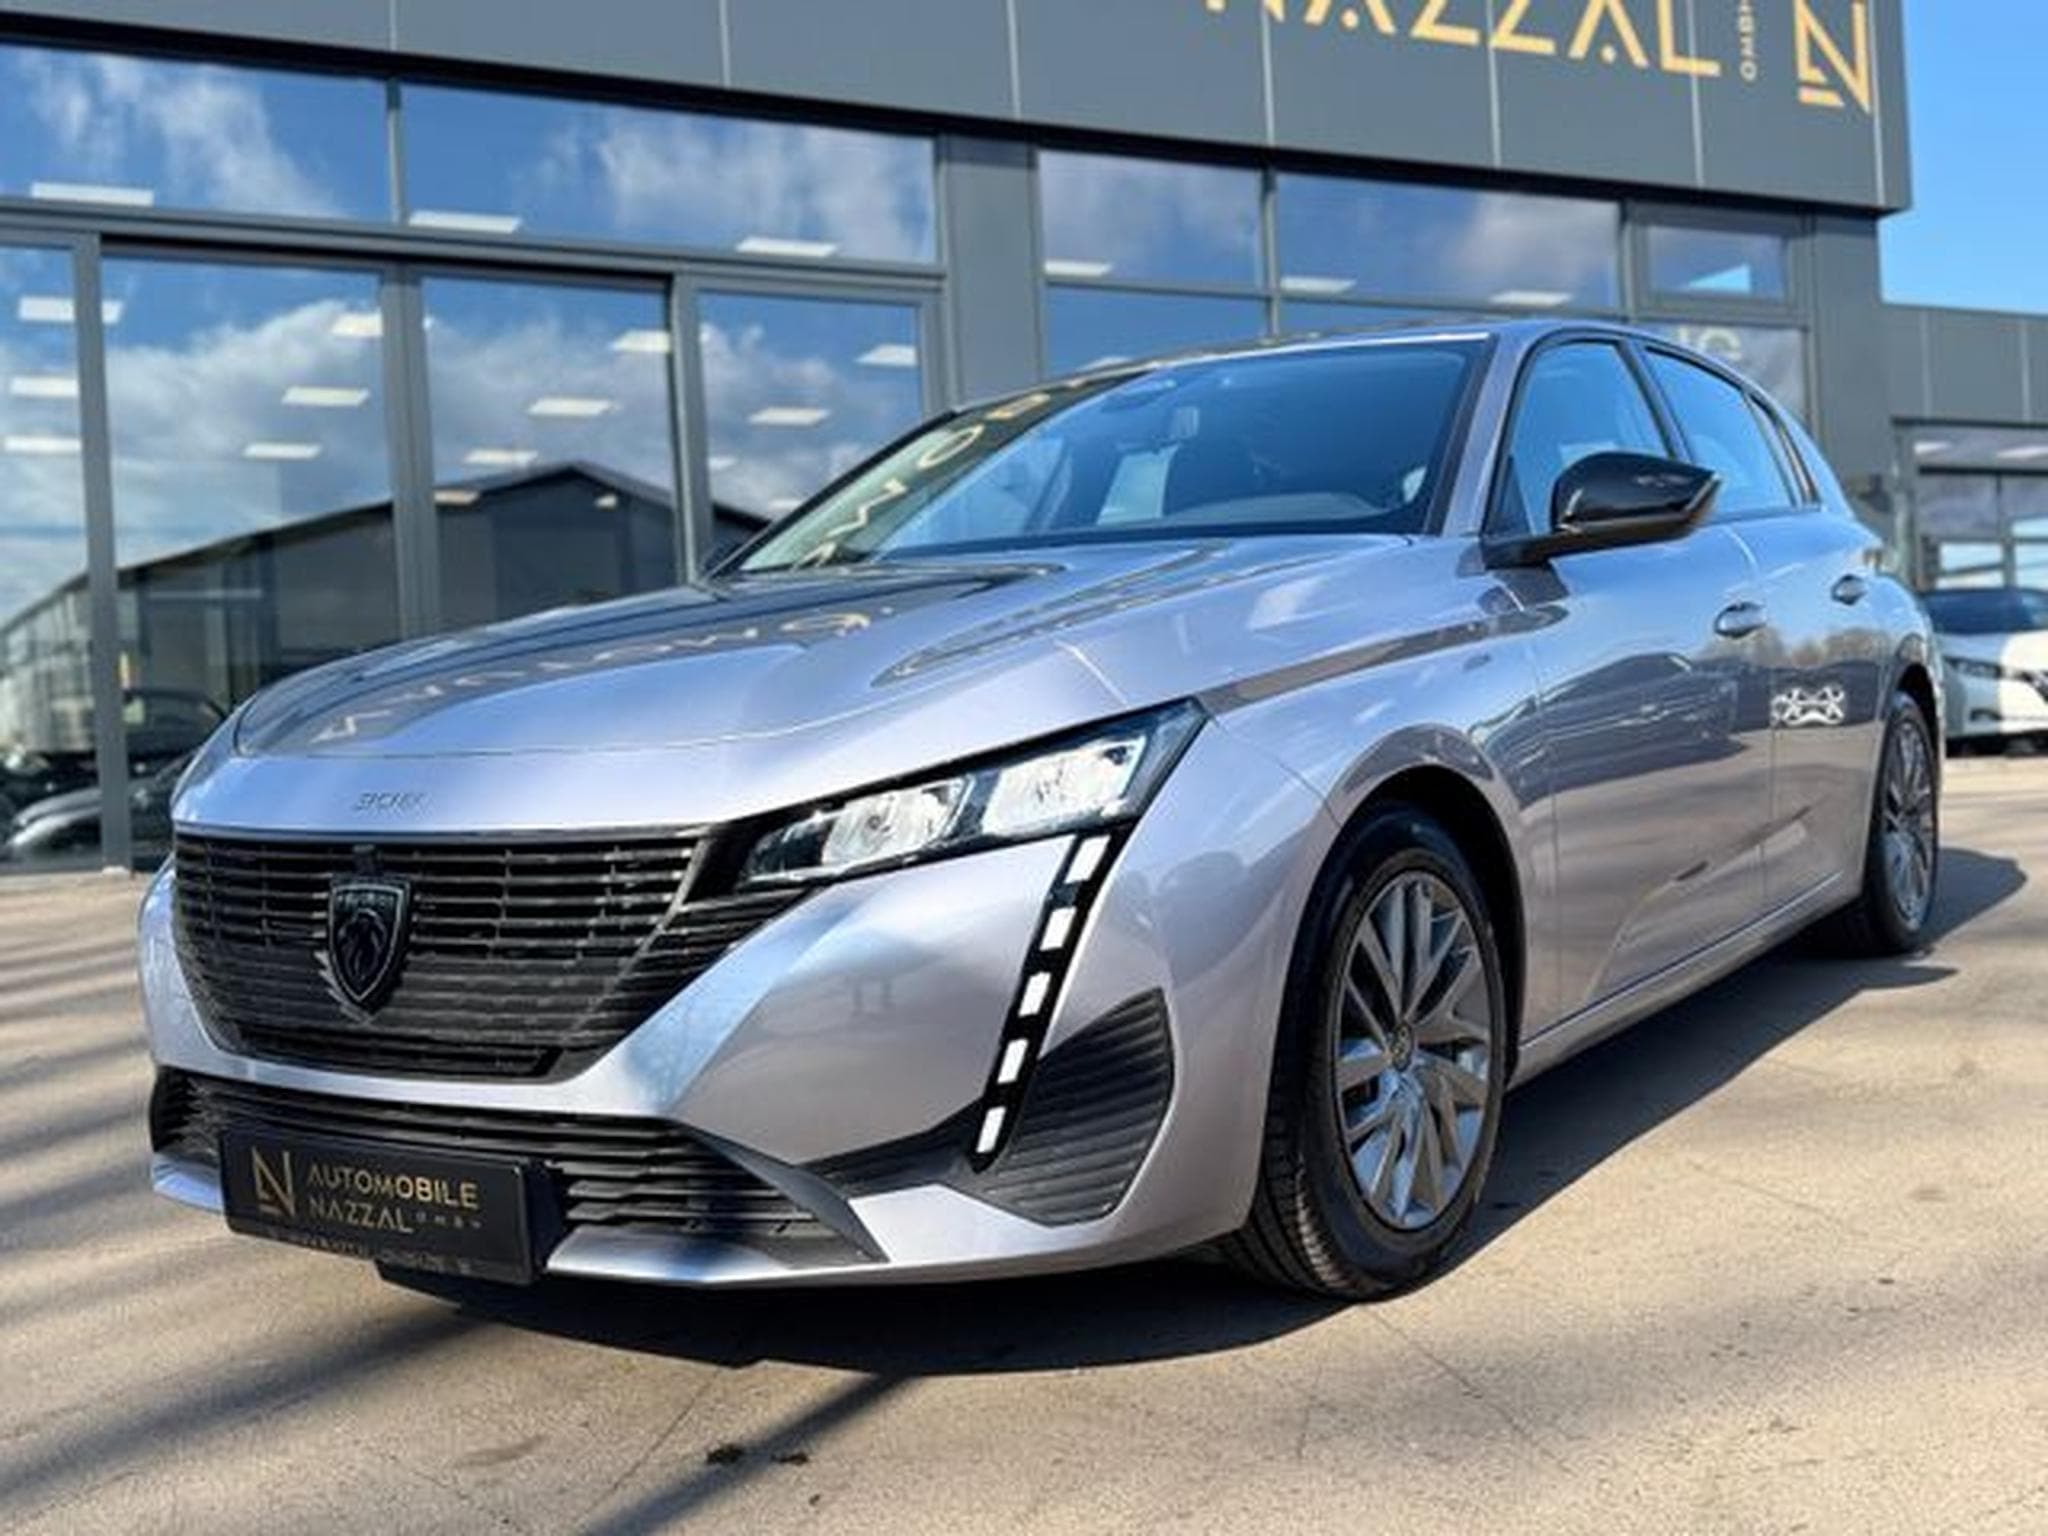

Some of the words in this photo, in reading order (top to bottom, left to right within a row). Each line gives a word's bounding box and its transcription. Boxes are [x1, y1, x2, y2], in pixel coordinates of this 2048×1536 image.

[1206, 0, 1721, 77] ZZAL
[251, 1145, 296, 1217] N
[306, 1163, 479, 1210] AUTOMOBILE
[309, 1194, 414, 1234] NAZZAL
